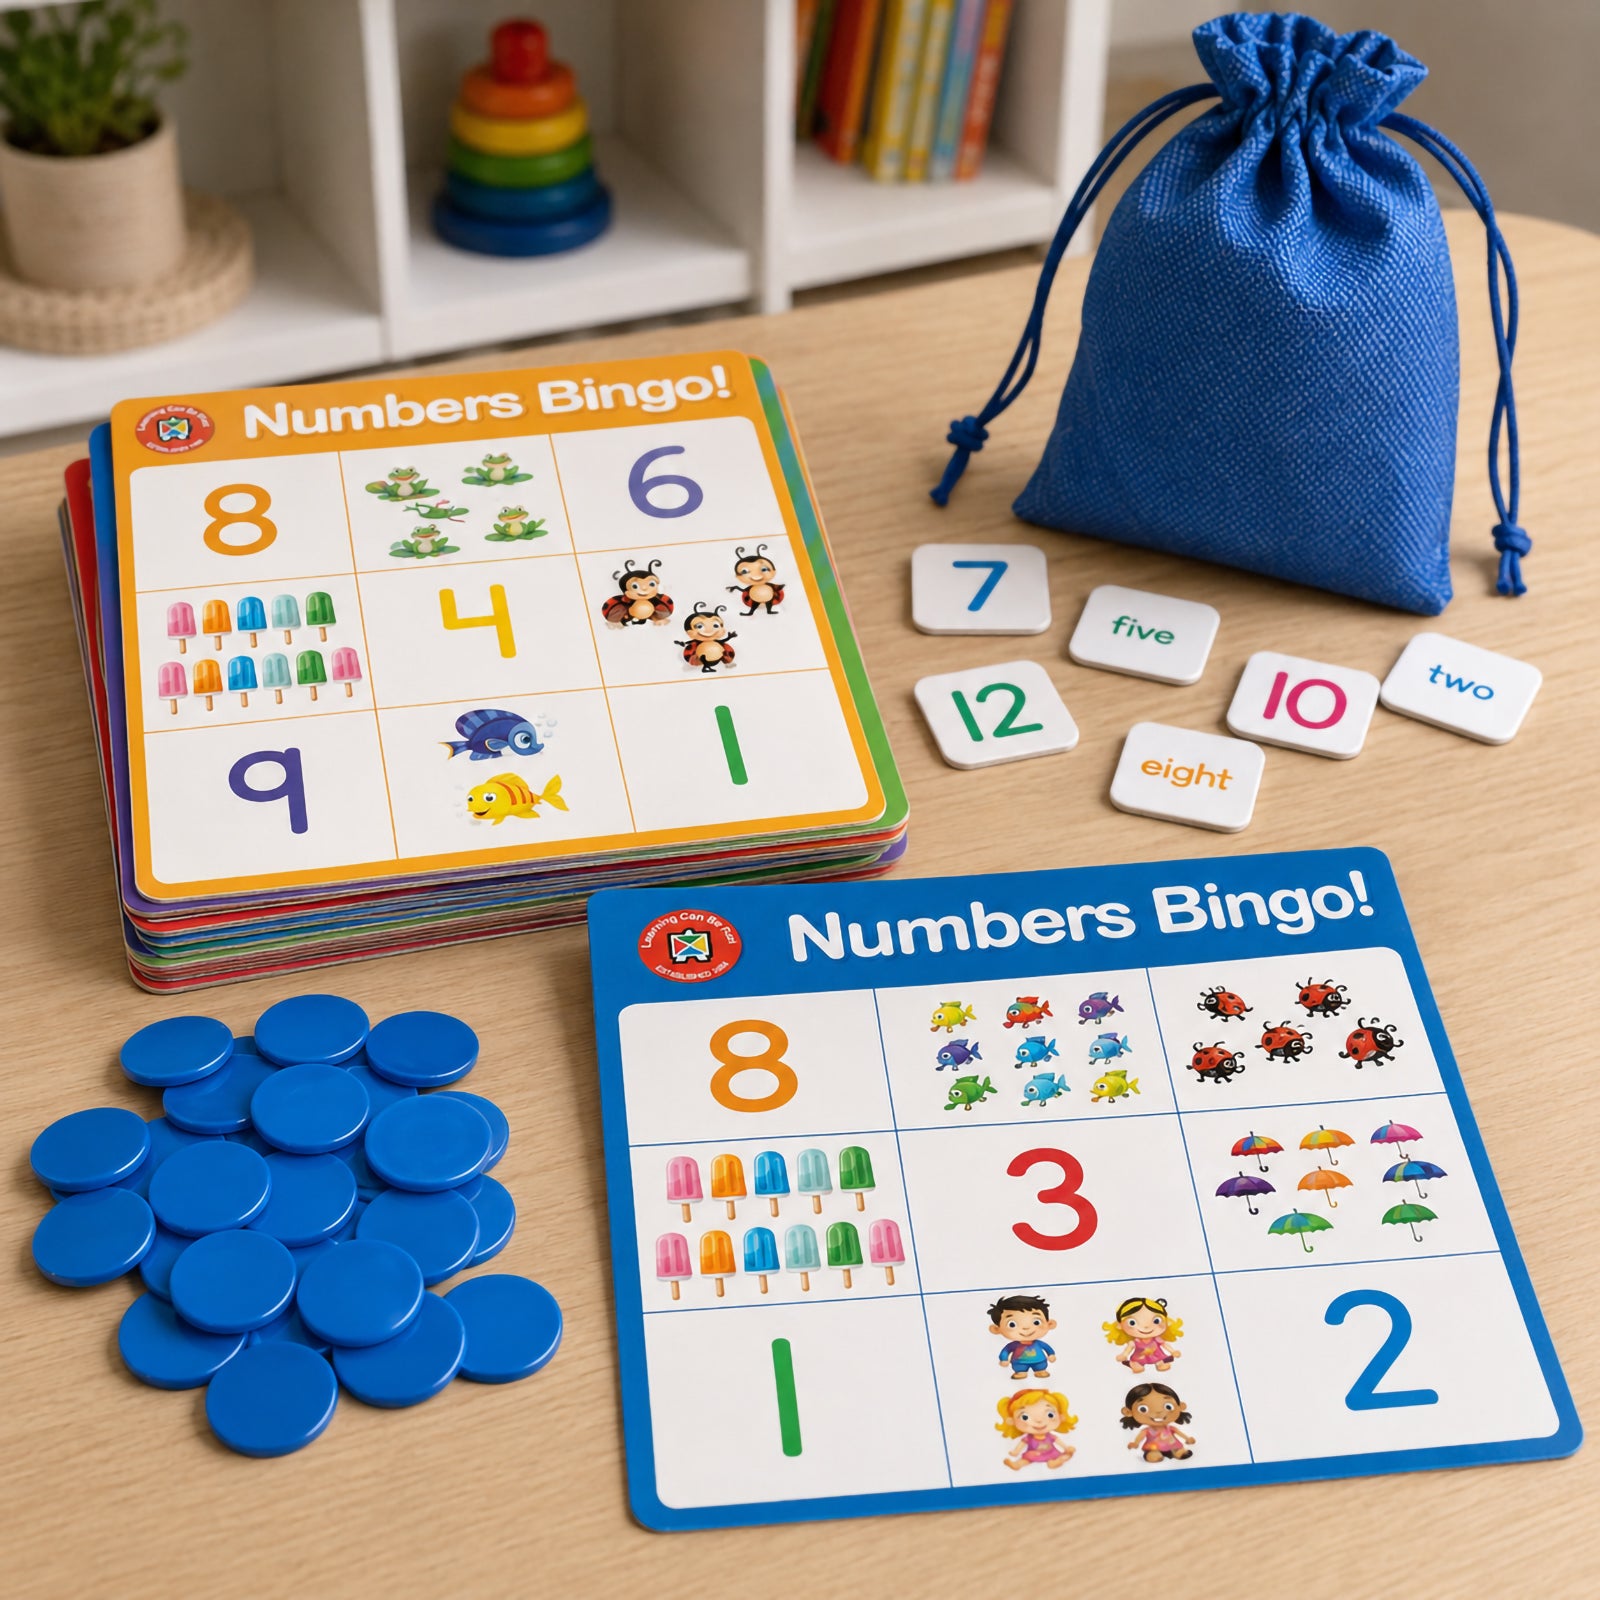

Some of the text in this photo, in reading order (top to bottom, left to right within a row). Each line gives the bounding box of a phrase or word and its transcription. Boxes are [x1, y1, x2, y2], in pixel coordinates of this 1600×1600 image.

[243, 364, 732, 439] Numbers Bingo!
[628, 445, 704, 519] 6
[203, 483, 277, 556] 8
[438, 583, 517, 659] 4
[952, 560, 1009, 612] 7
[1112, 615, 1175, 645] five
[951, 682, 1044, 742] 12
[1263, 671, 1348, 730] 10
[1429, 664, 1496, 701] two
[714, 705, 748, 786] 1
[1140, 757, 1234, 792] eight
[228, 747, 308, 834] 9
[680, 912, 704, 922] Can
[706, 915, 723, 928] Be
[788, 870, 1374, 964] Numbers Bingo!
[709, 1019, 799, 1114] 8
[1006, 1147, 1099, 1251] 3
[1324, 1289, 1439, 1412] 2
[771, 1338, 803, 1457] 1
